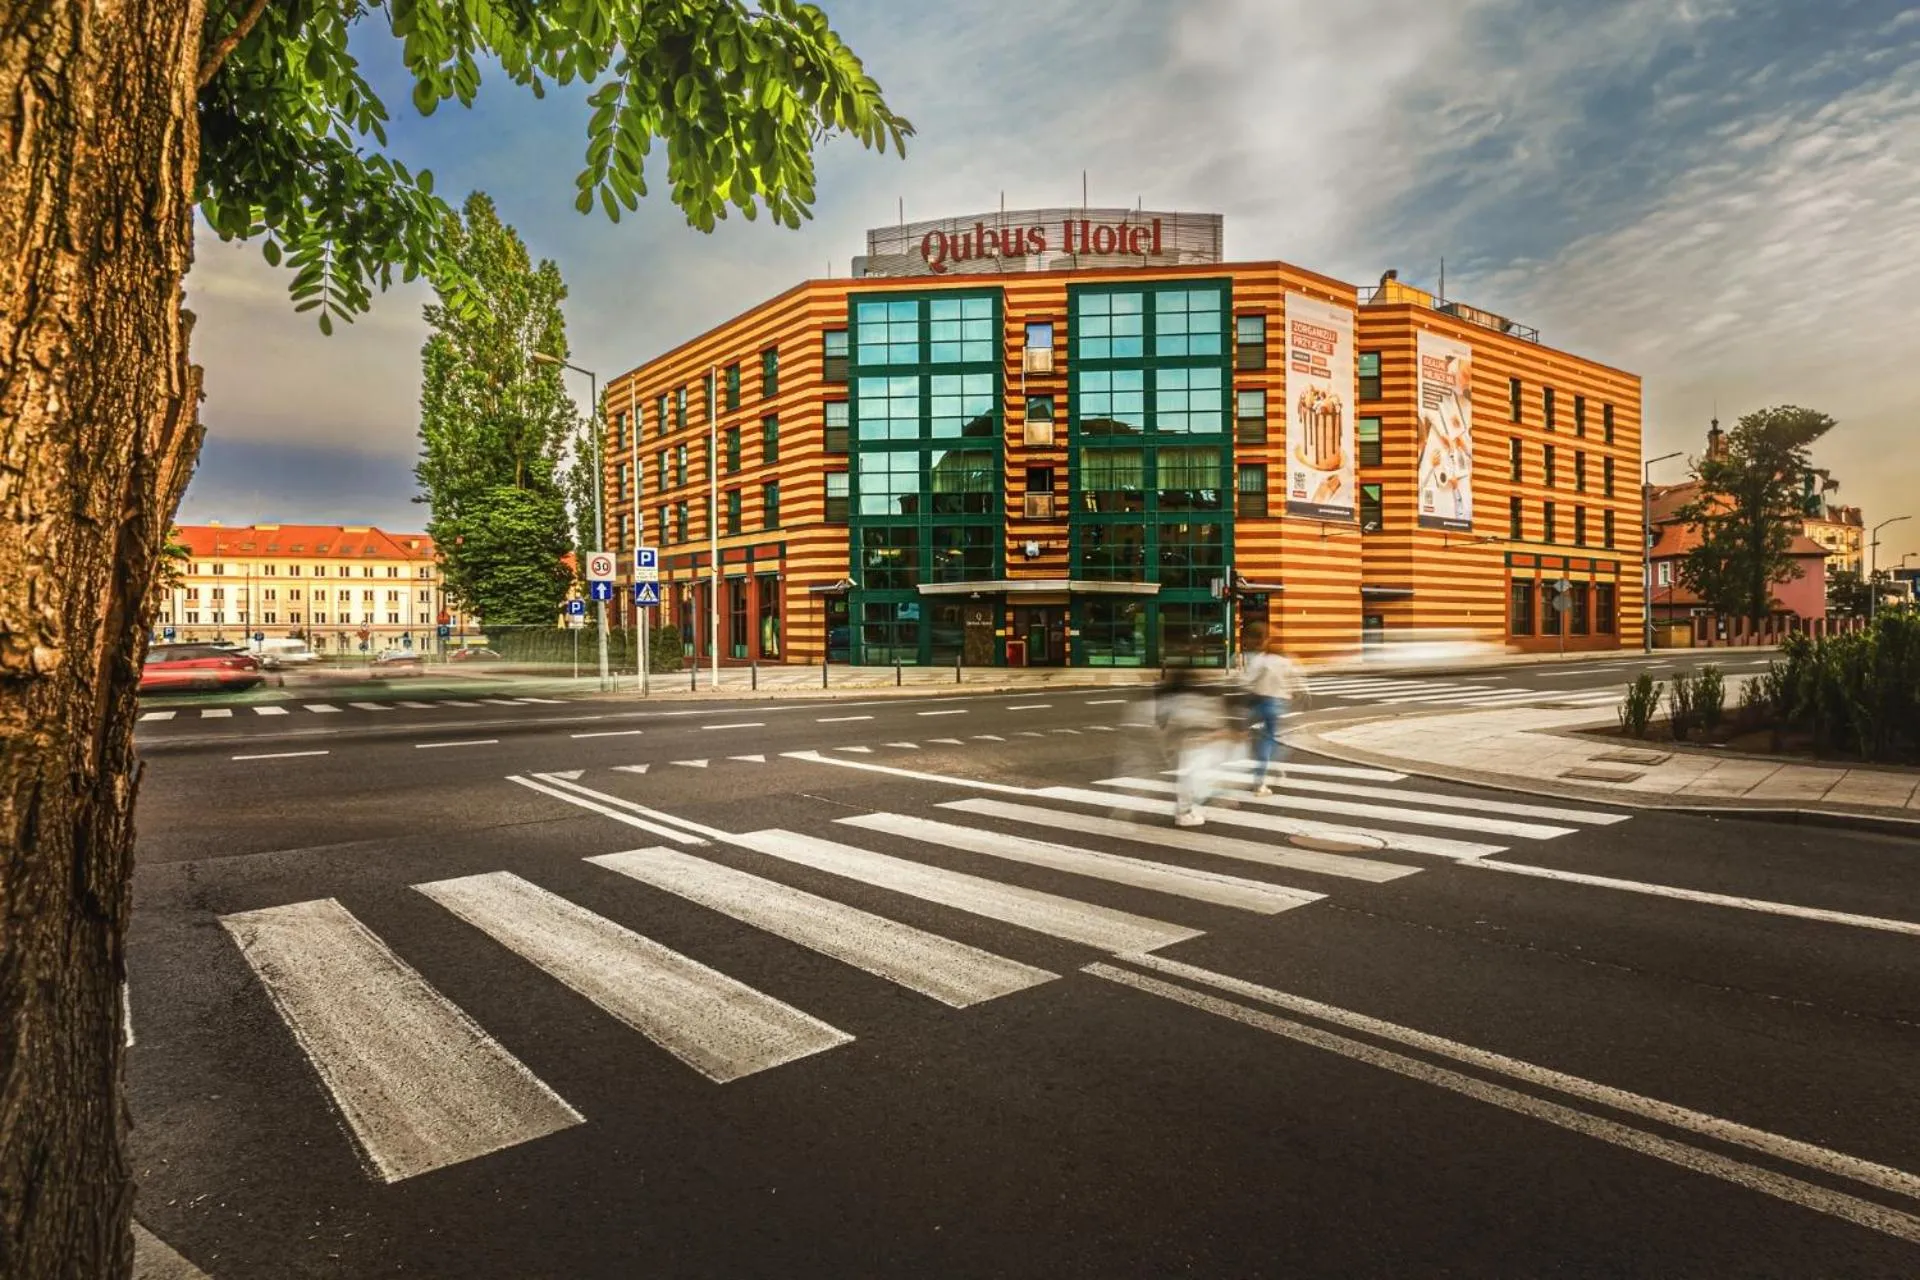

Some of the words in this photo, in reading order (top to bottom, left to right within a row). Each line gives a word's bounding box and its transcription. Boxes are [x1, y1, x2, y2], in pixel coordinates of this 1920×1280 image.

[921, 222, 1046, 273] Qubus
[1063, 218, 1163, 256] Hotel
[641, 552, 652, 566] P
[595, 562, 609, 571] 30
[571, 602, 581, 613] P
